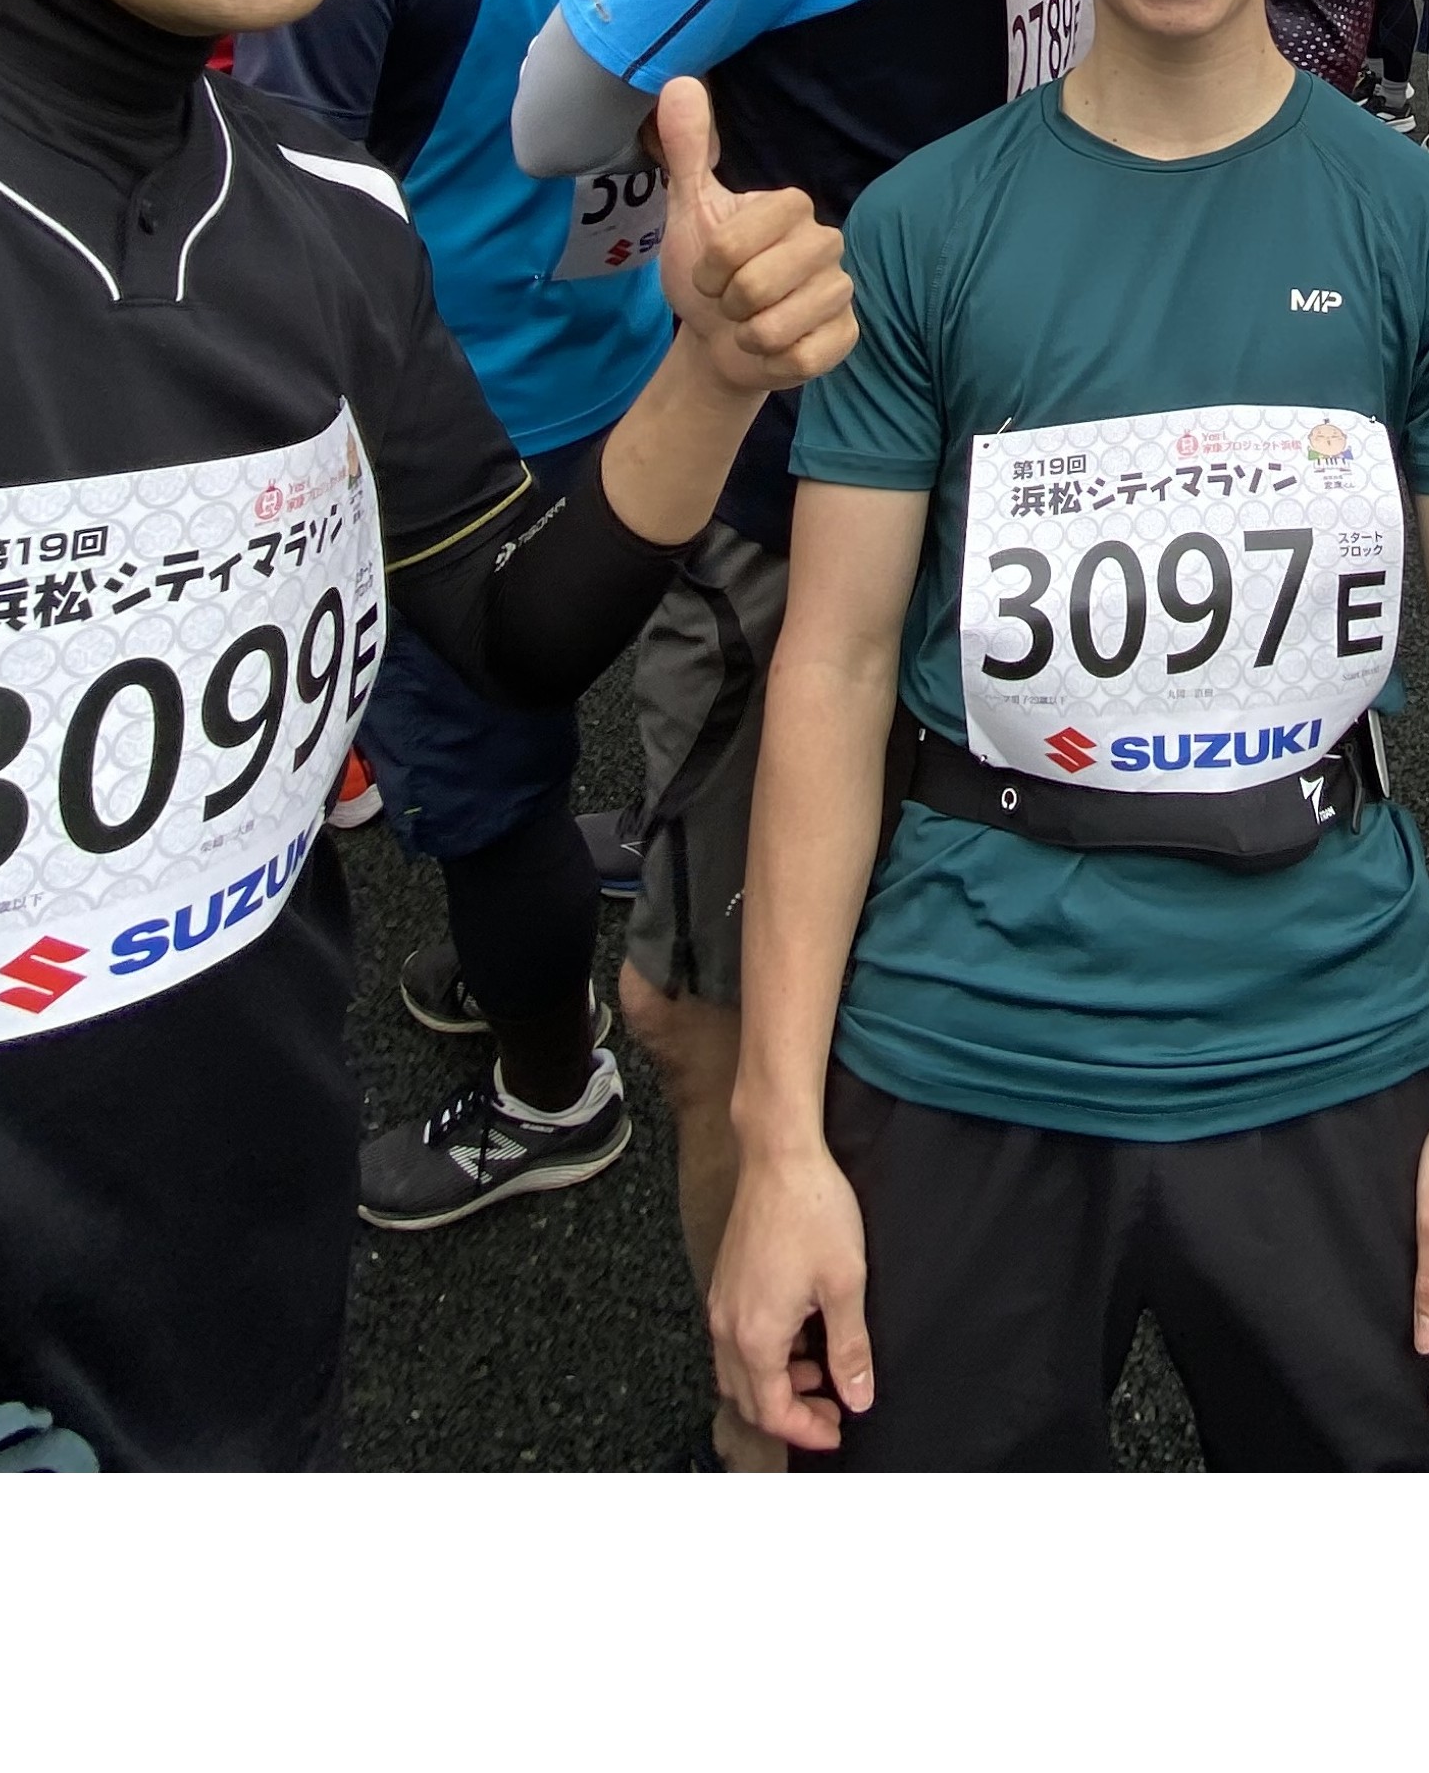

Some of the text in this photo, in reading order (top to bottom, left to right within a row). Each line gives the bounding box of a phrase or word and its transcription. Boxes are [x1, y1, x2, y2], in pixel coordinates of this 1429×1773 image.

[1291, 288, 1343, 313] MP
[1013, 454, 1087, 481] 第19回
[1010, 463, 1299, 518] 浜松シティマラソン
[1339, 531, 1383, 544] スタート
[1340, 545, 1383, 557] ブロック
[981, 528, 1386, 681] 3097 E
[346, 602, 378, 724] E
[1110, 718, 1322, 772] SUZUKI
